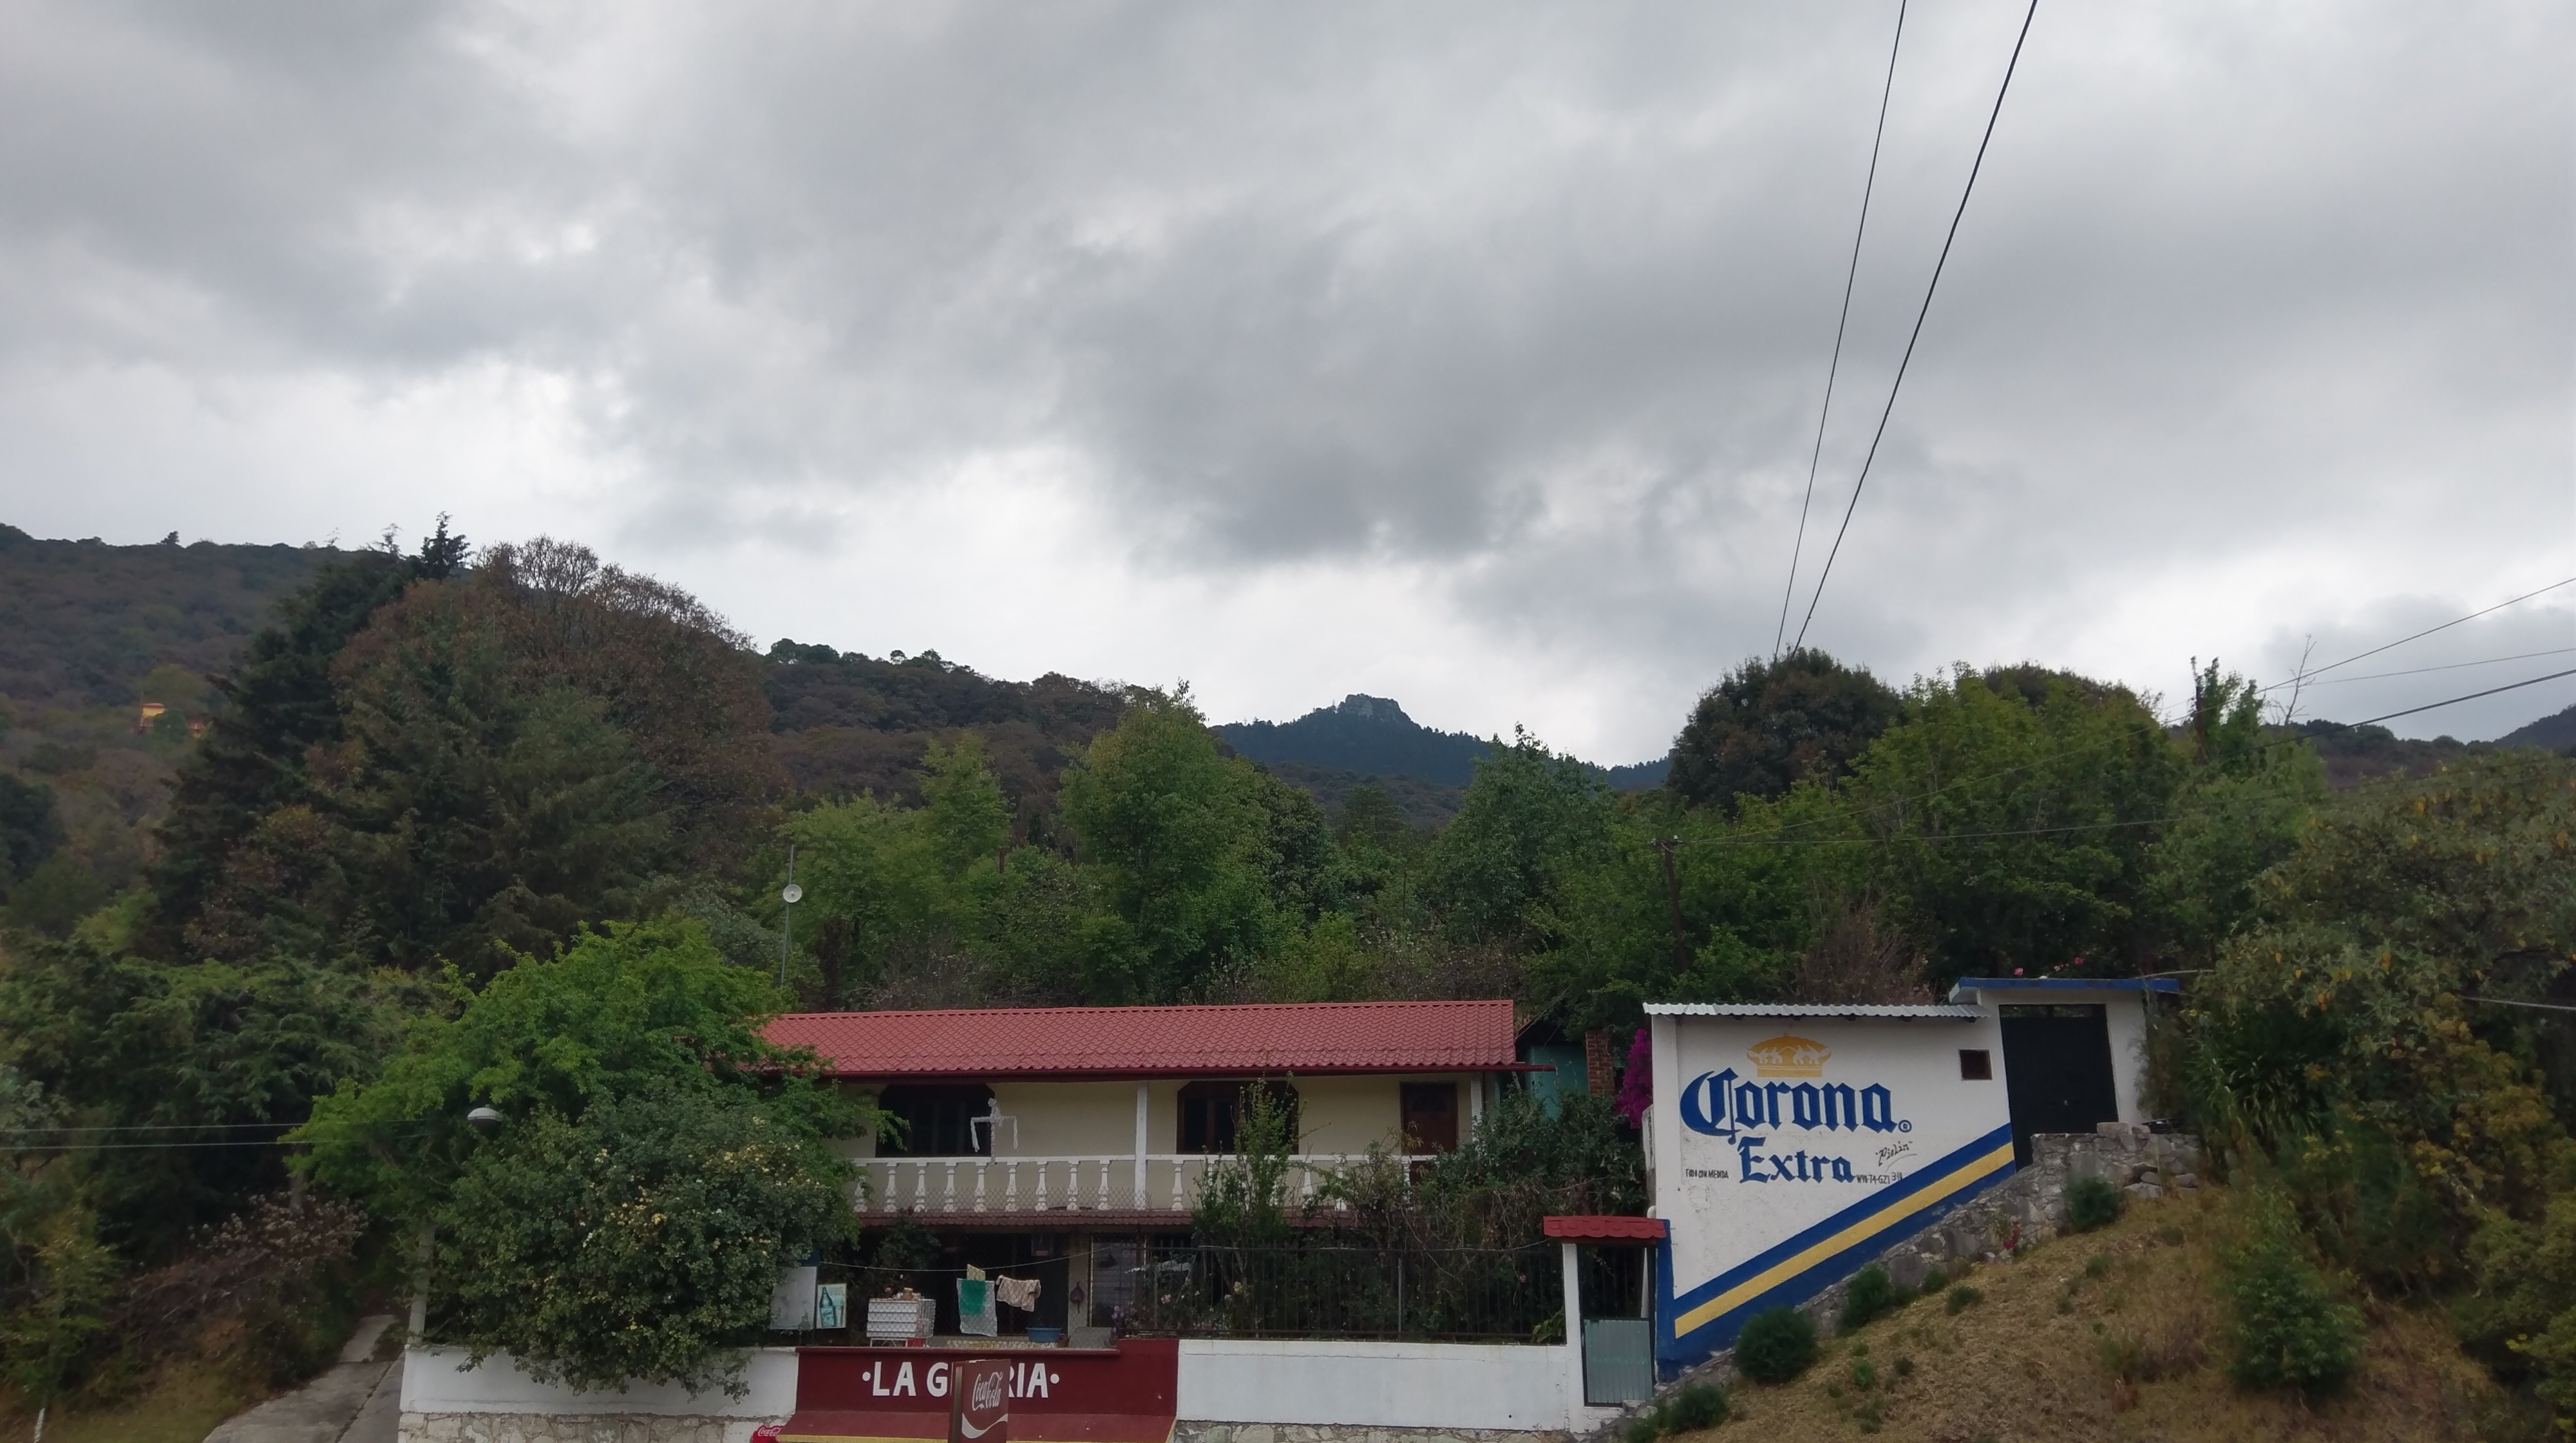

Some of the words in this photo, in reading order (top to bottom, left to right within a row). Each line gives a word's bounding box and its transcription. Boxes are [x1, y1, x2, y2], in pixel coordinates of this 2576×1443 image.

[1680, 1067, 1897, 1145] Corona
[1738, 1136, 1855, 1183] Extra
[872, 1361, 917, 1397] LA
